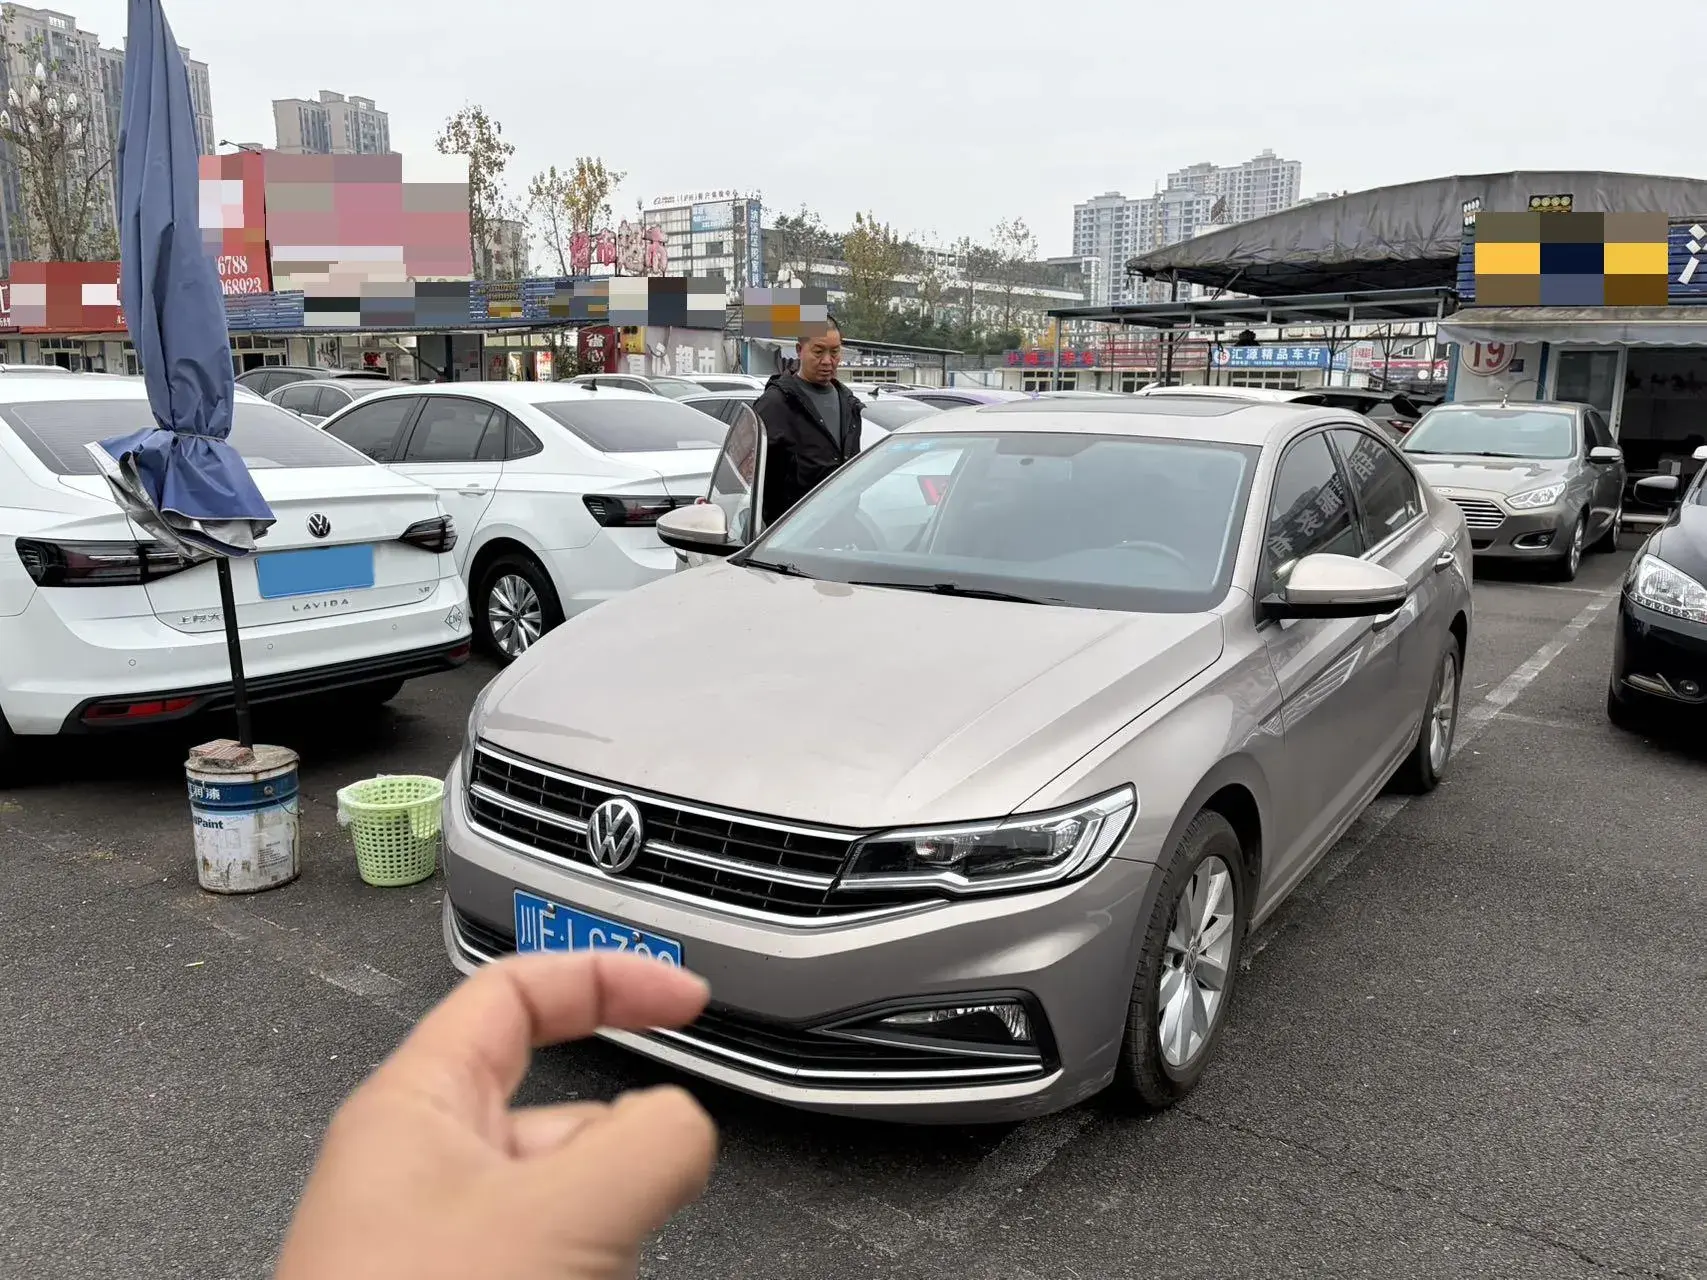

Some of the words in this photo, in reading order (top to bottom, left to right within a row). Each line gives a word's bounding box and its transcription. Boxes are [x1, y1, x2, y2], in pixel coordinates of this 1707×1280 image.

[1231, 348, 1321, 361] 汇源精品车行
[1470, 341, 1505, 368] 19
[291, 598, 350, 612] LAVIDA
[179, 613, 221, 625] 上汽大
